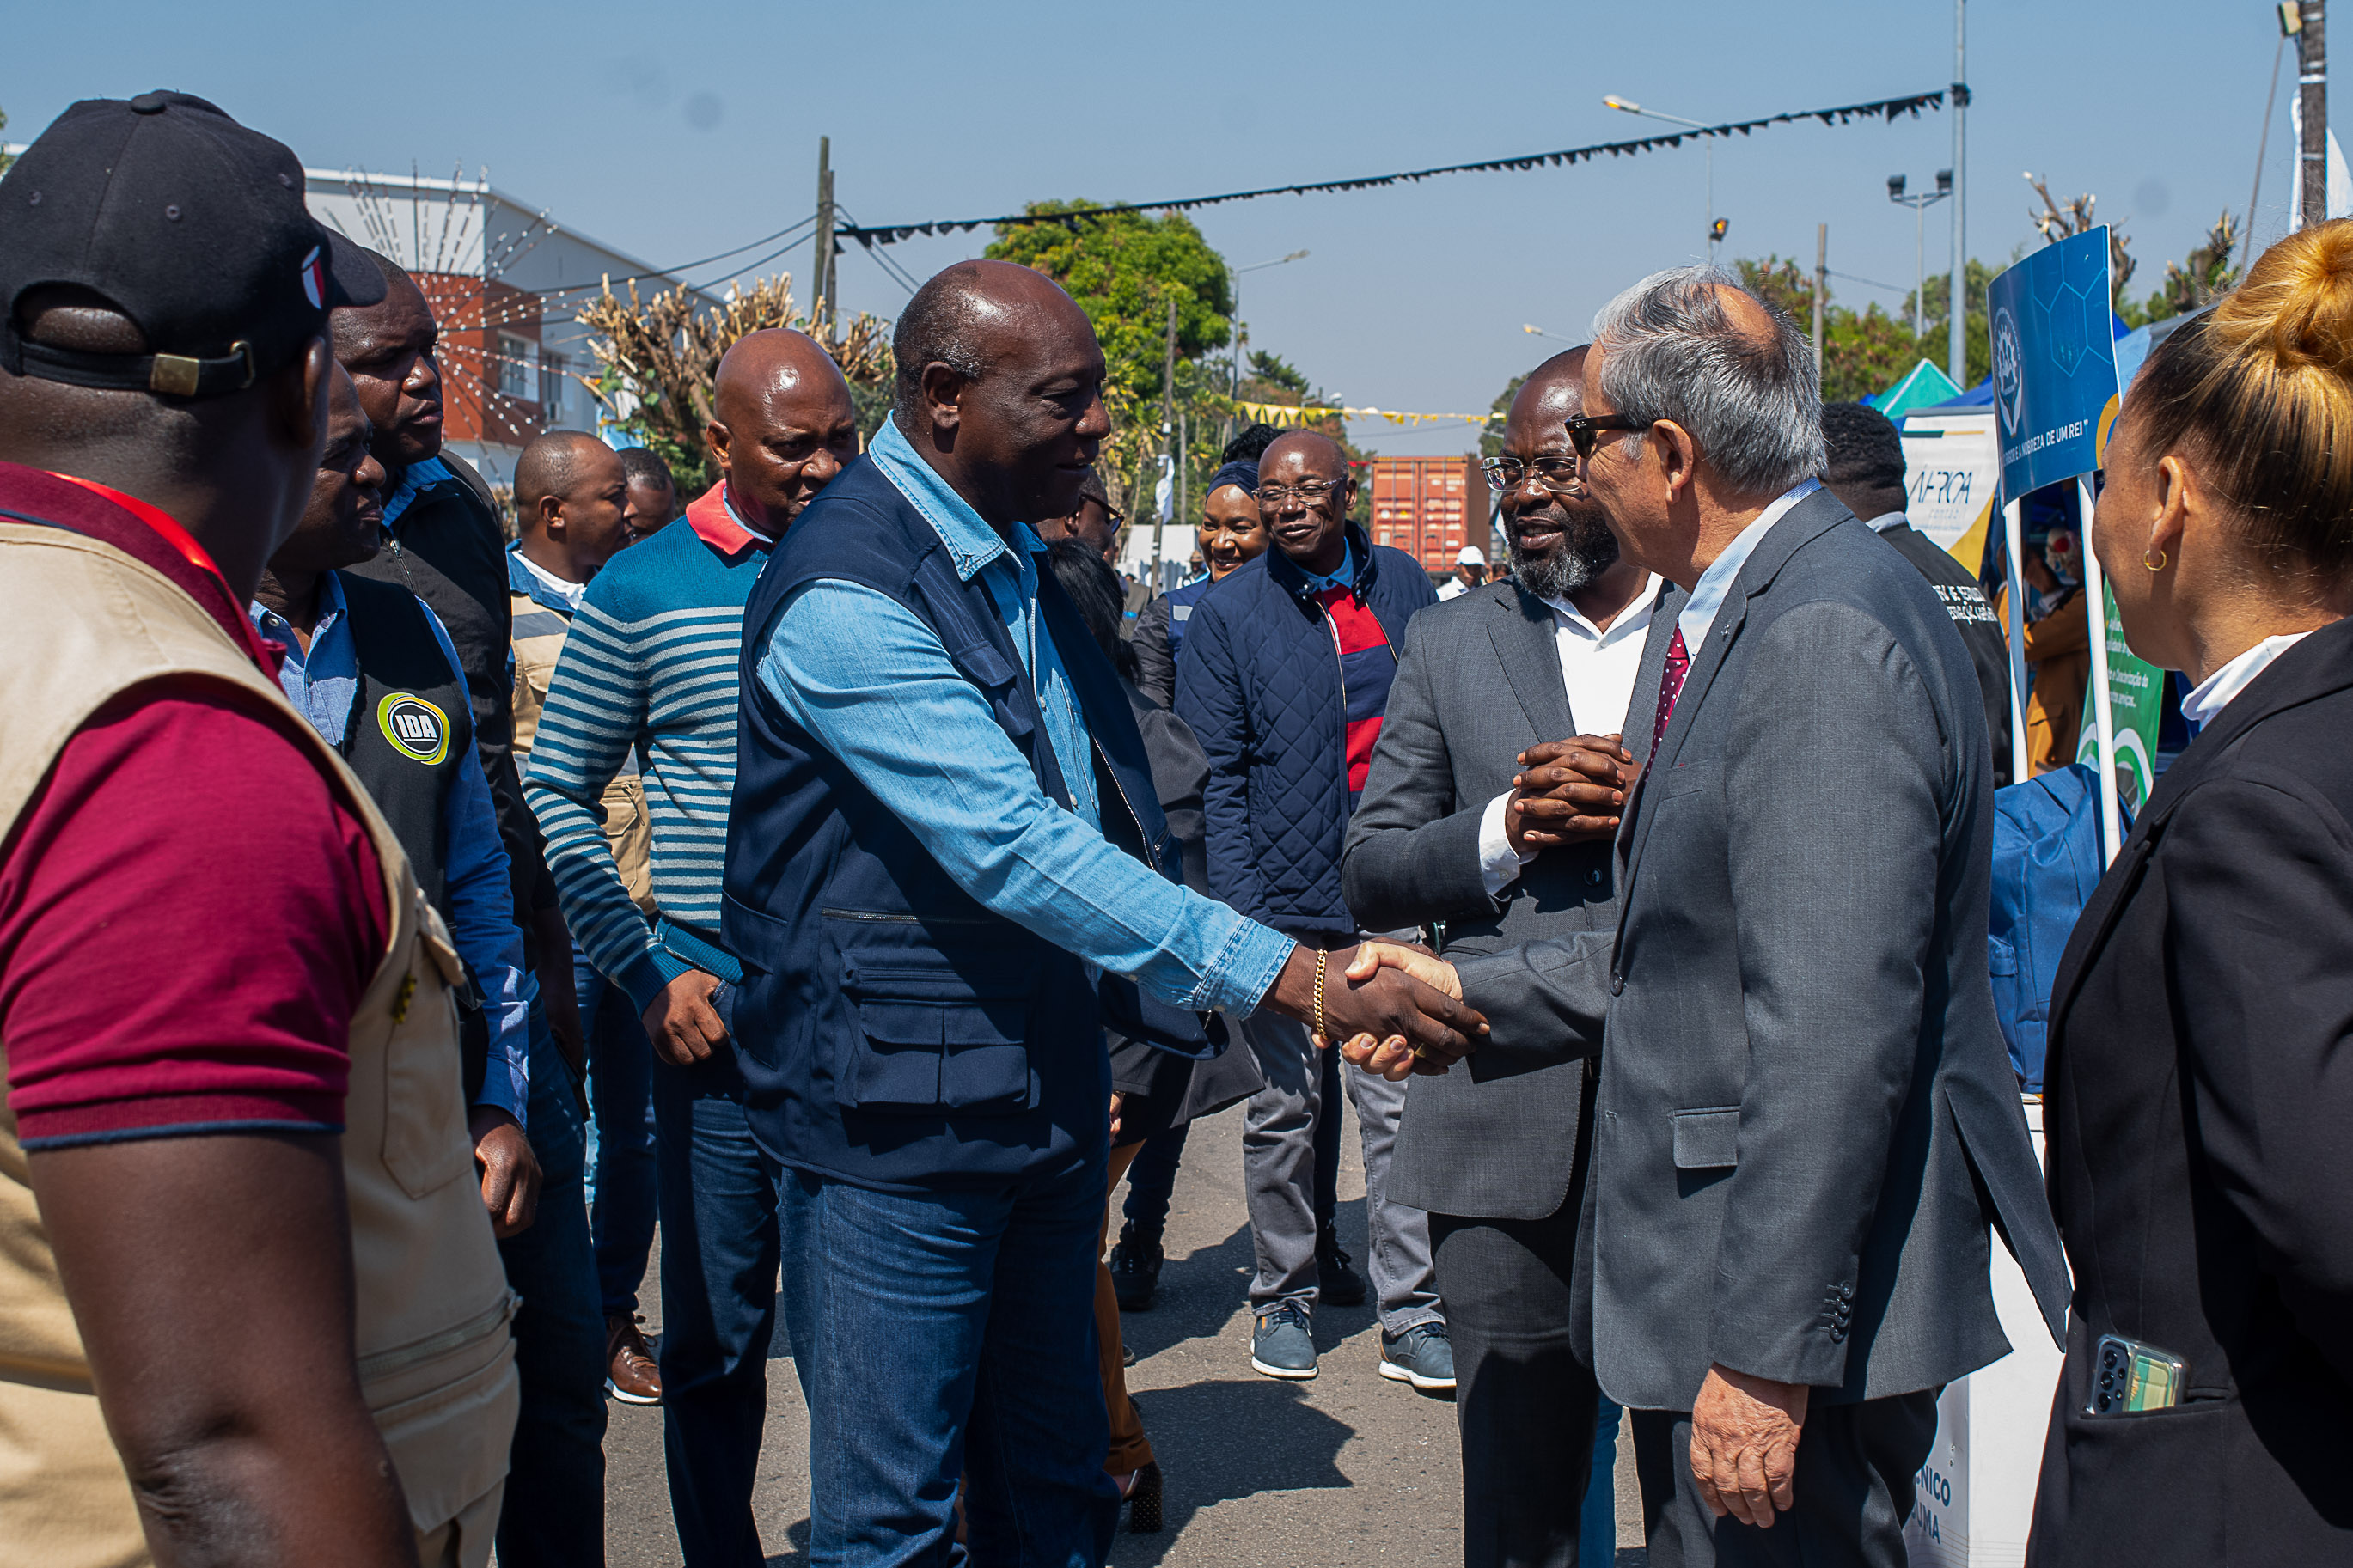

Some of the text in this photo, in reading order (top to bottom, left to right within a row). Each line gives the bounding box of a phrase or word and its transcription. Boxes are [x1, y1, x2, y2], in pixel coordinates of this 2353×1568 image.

[2022, 434, 2044, 457] NOBREZA
[2046, 430, 2056, 447] DE
[2056, 425, 2068, 442] UM
[2069, 421, 2083, 439] REI
[395, 714, 438, 738] IDA
